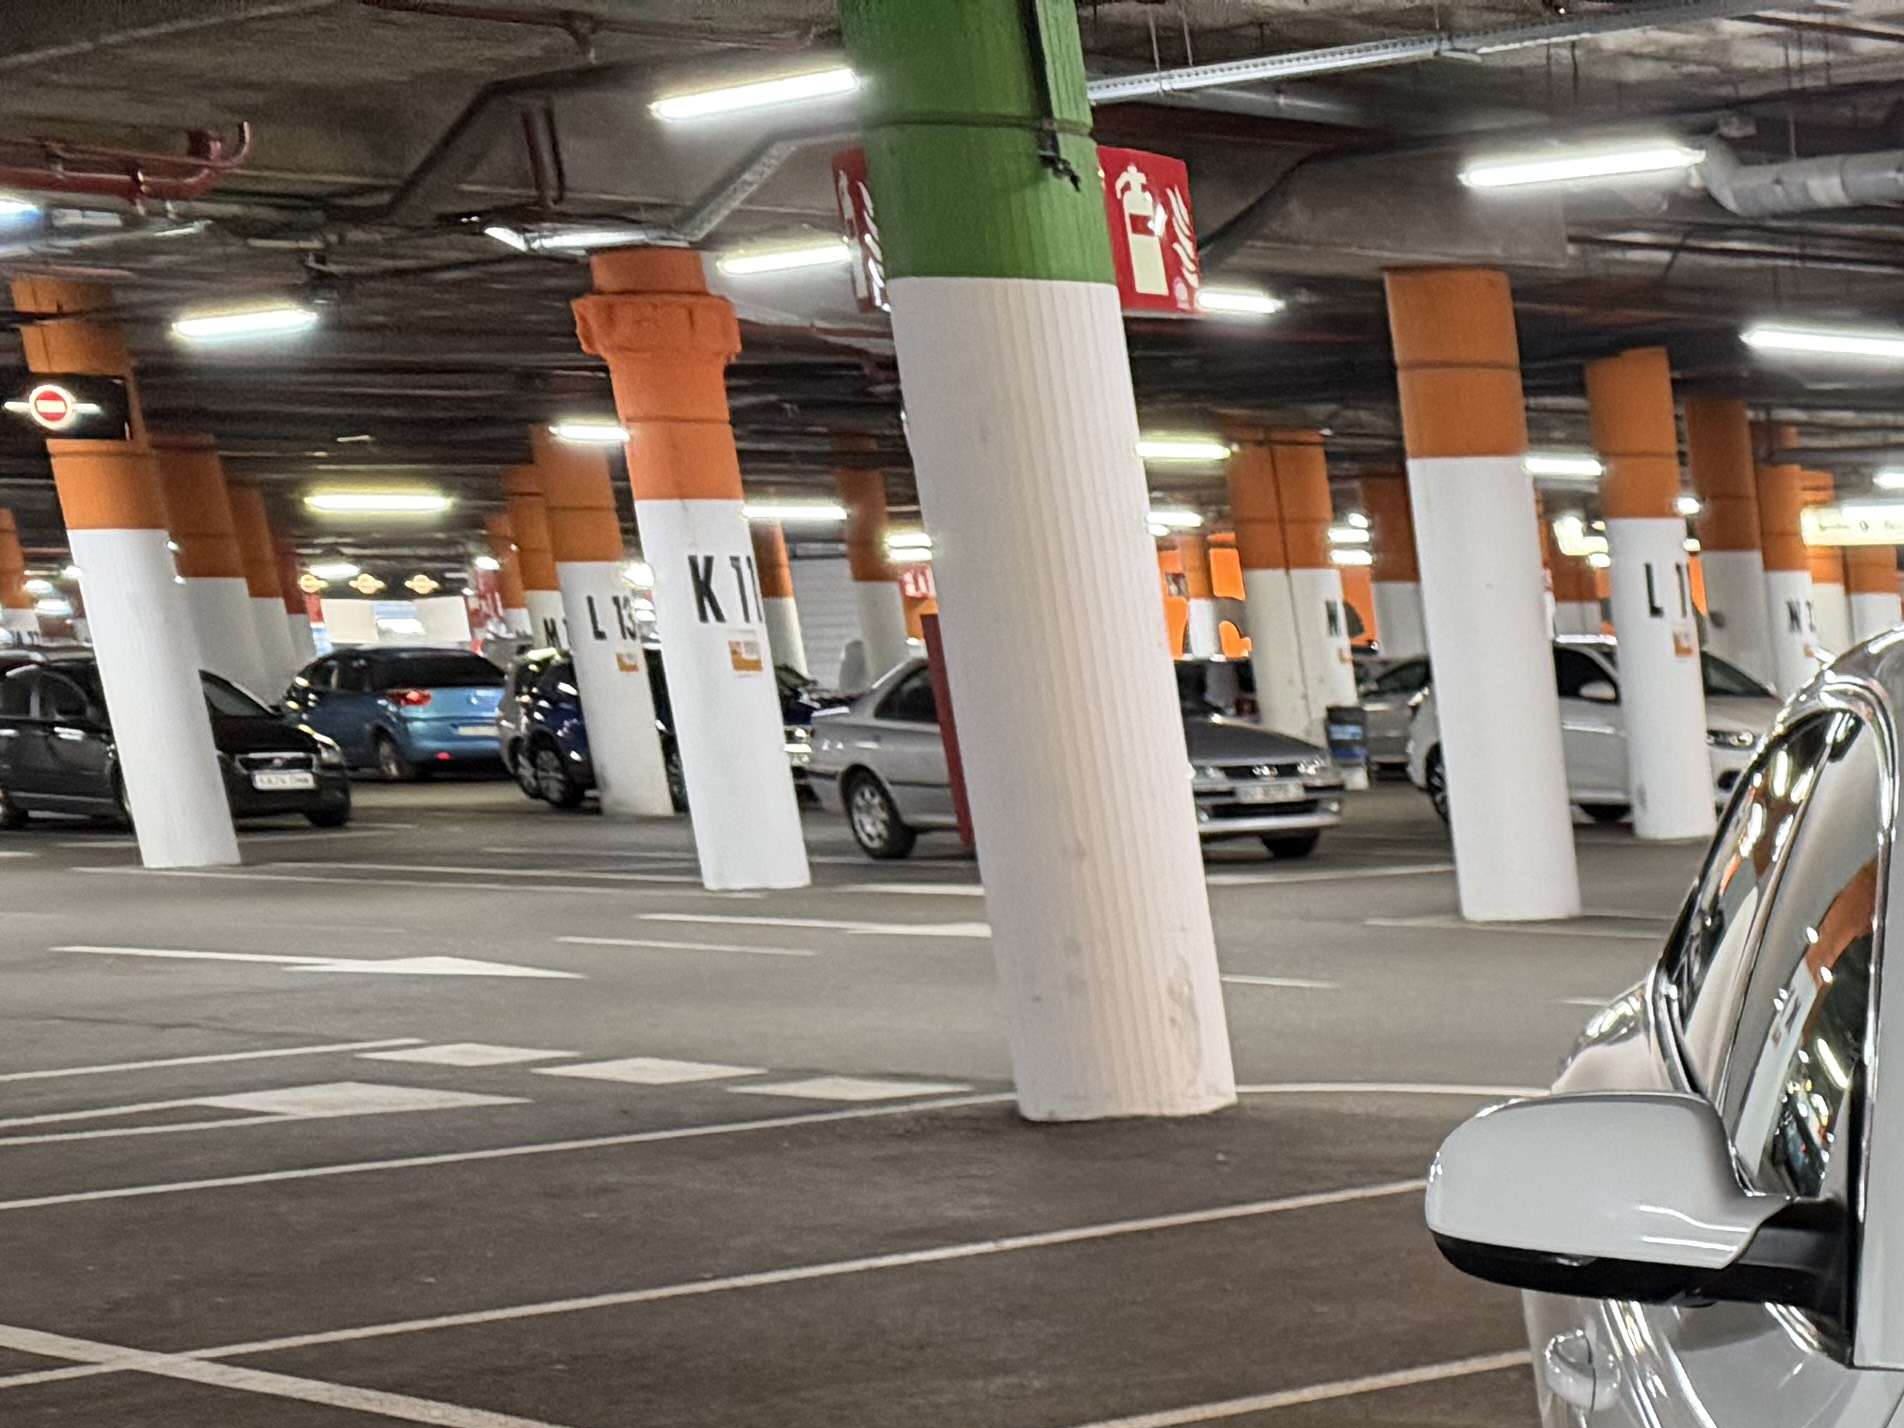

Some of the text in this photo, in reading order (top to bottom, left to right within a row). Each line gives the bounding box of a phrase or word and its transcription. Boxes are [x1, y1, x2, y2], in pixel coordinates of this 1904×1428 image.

[688, 555, 726, 623] K
[1644, 562, 1664, 618] L
[586, 595, 608, 641] L
